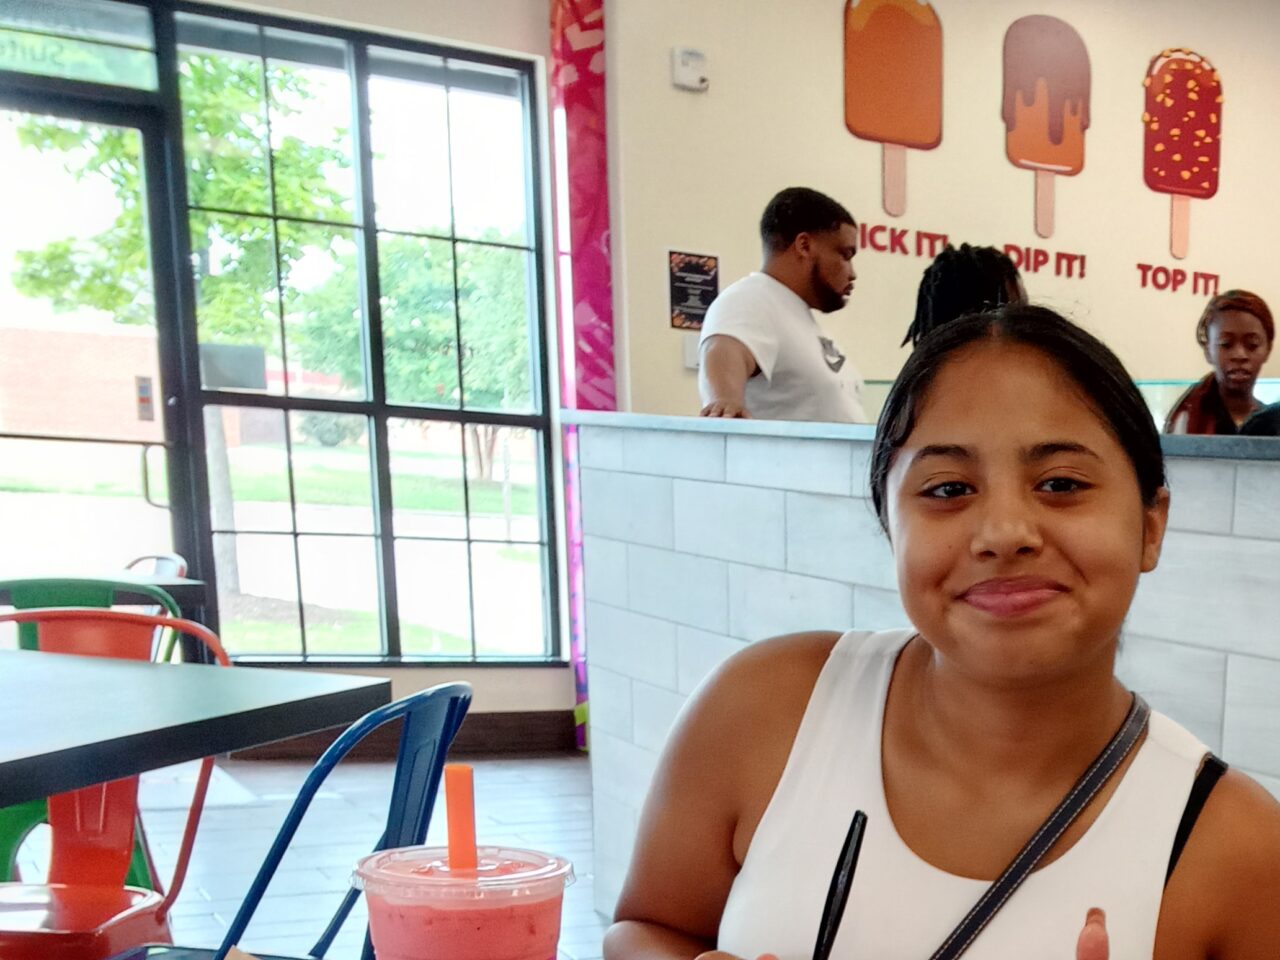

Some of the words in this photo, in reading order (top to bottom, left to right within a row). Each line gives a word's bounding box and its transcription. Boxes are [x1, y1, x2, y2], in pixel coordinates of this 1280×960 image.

[1003, 244, 1050, 273] DIP
[1055, 252, 1087, 279] IT!
[1136, 263, 1187, 292] TOP
[1193, 271, 1219, 297] IT!
